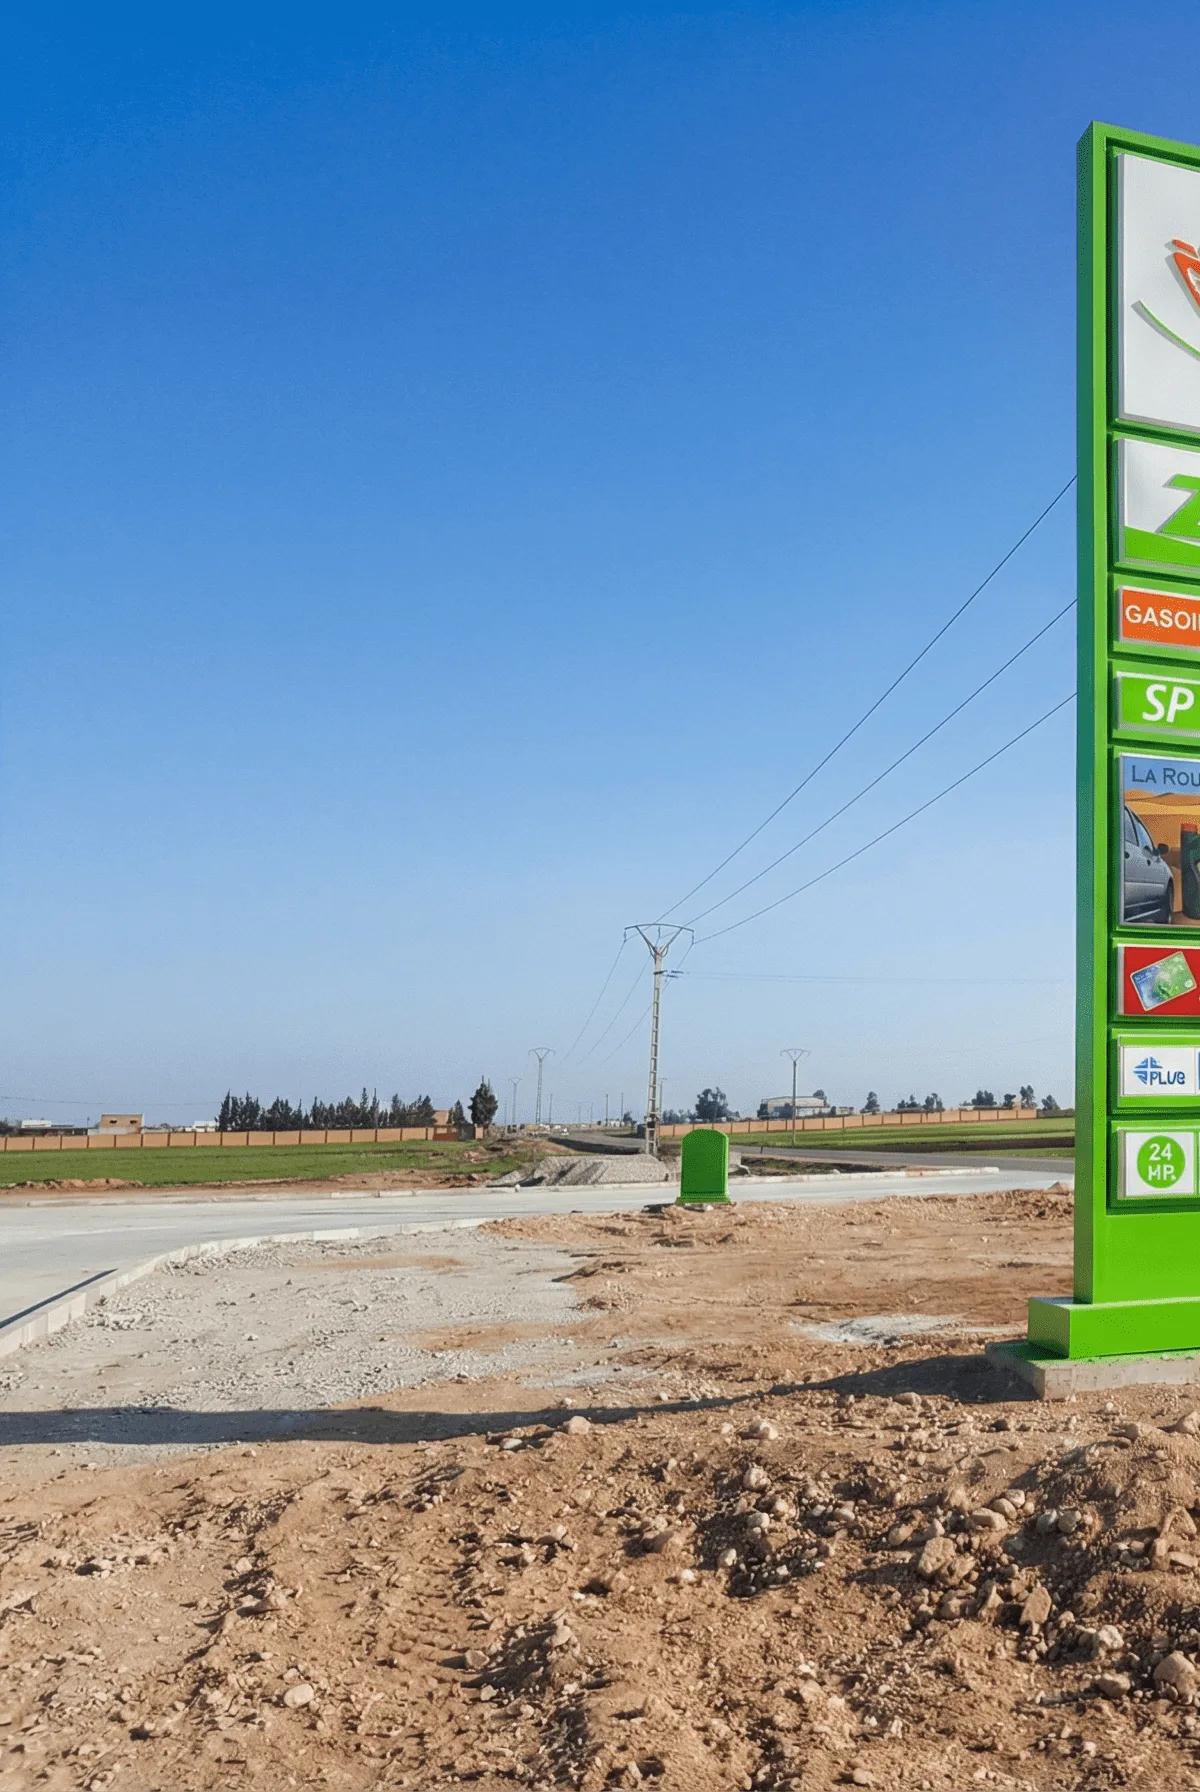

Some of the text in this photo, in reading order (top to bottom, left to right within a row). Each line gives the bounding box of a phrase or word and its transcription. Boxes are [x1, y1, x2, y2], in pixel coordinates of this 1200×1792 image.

[1142, 683, 1195, 722] SP
[1131, 765, 1157, 784] LA
[1148, 1142, 1173, 1161] 24
